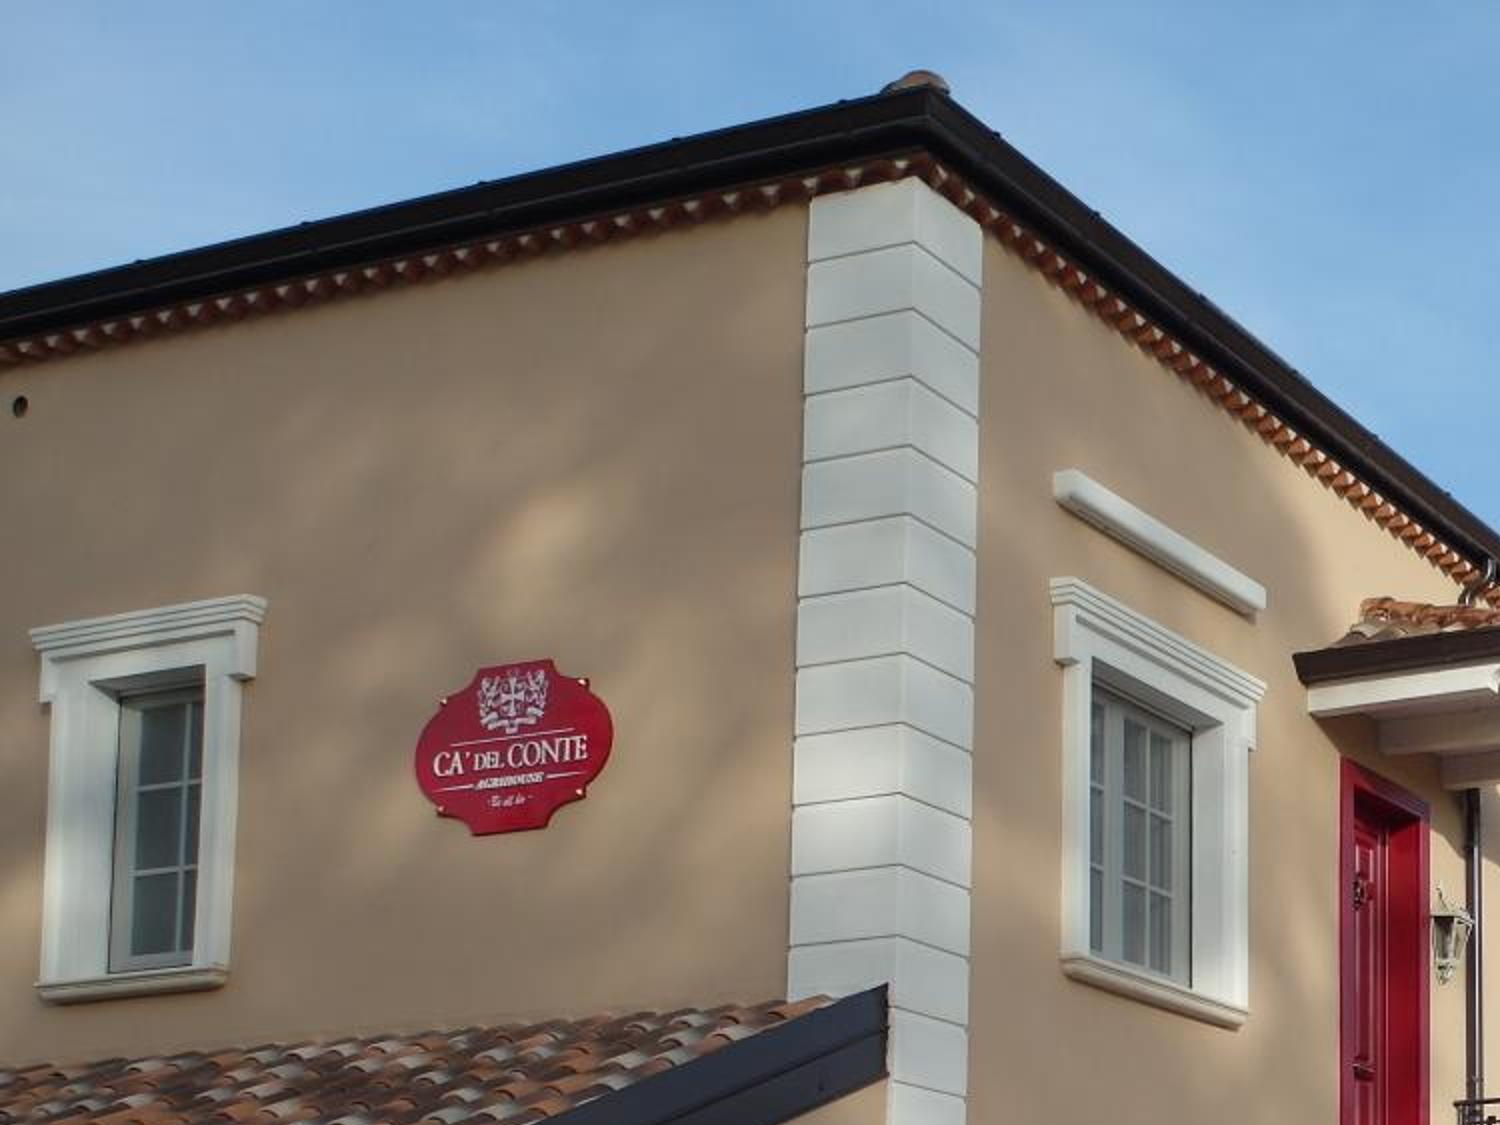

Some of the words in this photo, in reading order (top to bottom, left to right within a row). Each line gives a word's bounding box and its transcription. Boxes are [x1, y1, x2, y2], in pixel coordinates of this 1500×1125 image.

[433, 752, 471, 776] CA'
[474, 752, 504, 771] DEL
[508, 736, 588, 767] CONTE
